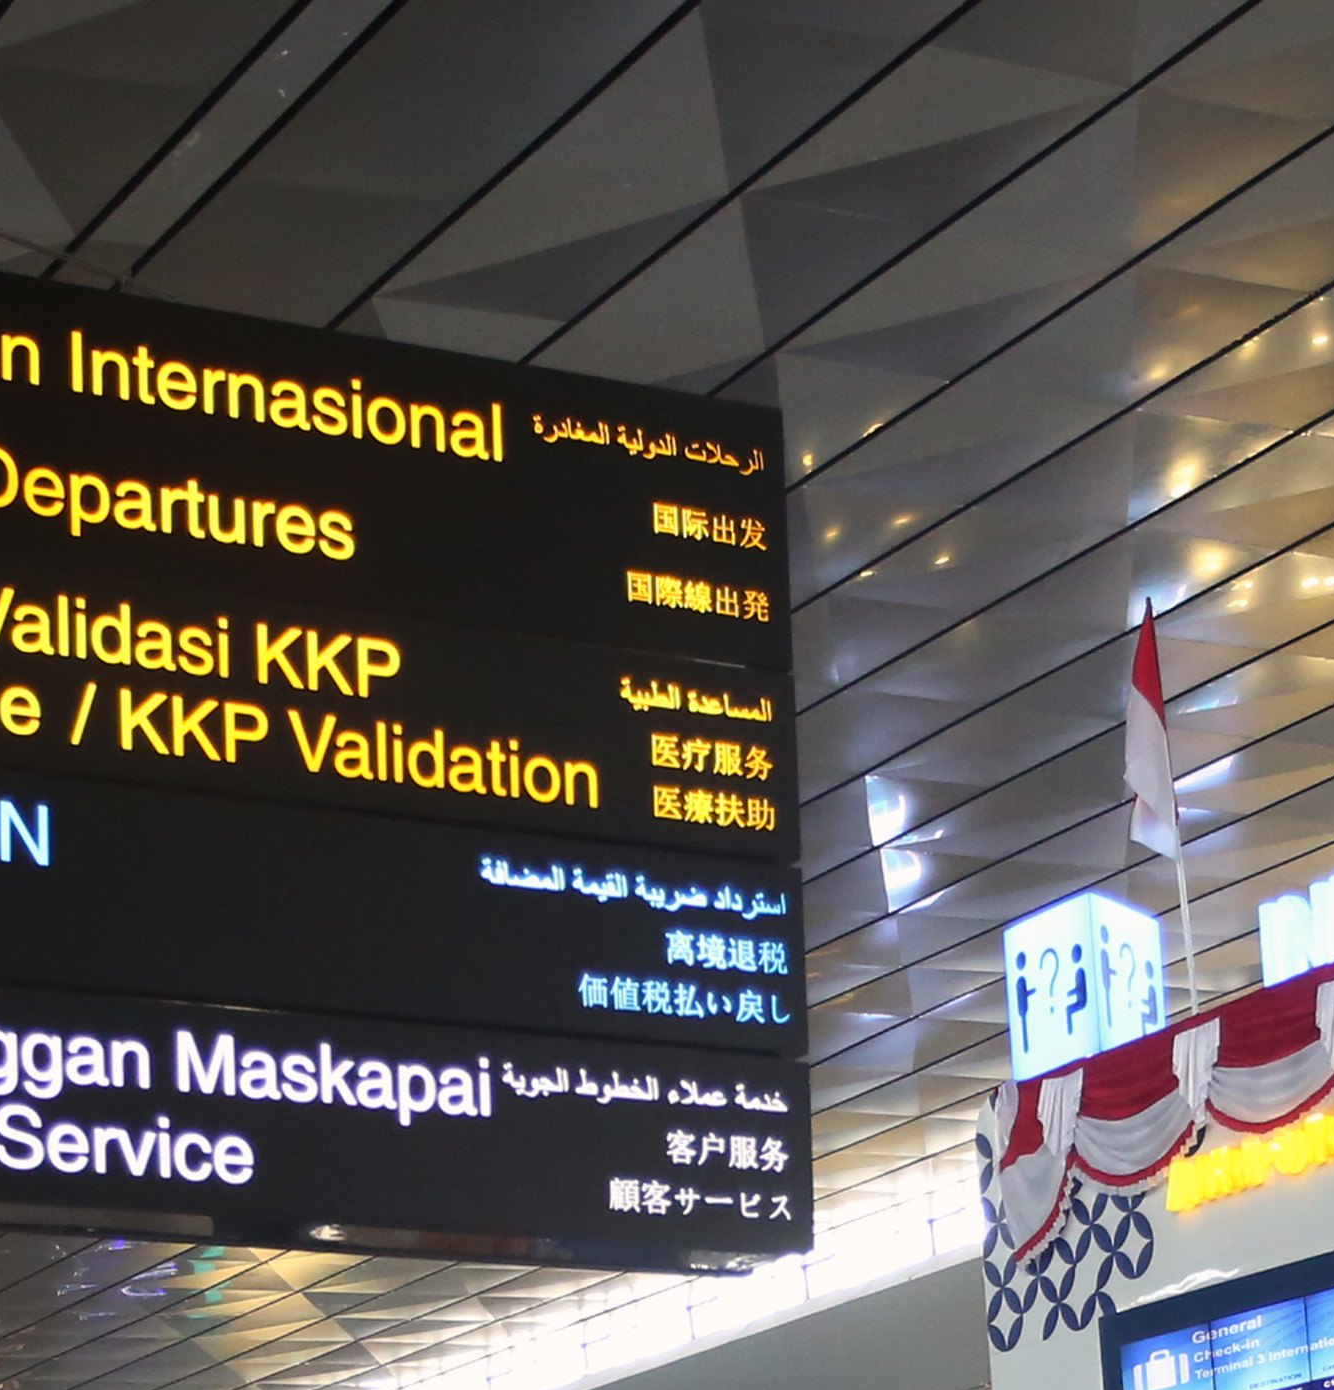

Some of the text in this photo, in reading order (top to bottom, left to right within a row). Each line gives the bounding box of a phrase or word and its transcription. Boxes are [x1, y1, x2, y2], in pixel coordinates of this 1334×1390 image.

[71, 330, 503, 462] Internasional
[532, 414, 764, 475] الرحلات الدولية المغادرة
[653, 501, 766, 550] 国际出发
[626, 569, 769, 622] 国際線出発
[255, 621, 400, 698] KKP
[619, 676, 773, 723] المساعدة الطبية
[70, 681, 97, 745] /
[119, 687, 268, 763] KKP
[287, 708, 599, 808] Validation
[651, 732, 773, 780] 医疗服务
[653, 784, 775, 831] 医療扶助
[480, 855, 787, 921] استرداد ضريبة القيمة المضافة
[665, 926, 789, 975] 离境退税
[577, 971, 790, 1024] 価値税払い戻し
[173, 1028, 492, 1127] Maskapai
[501, 1062, 788, 1112] خدمة عملاء الخطوط الجوية
[666, 1128, 789, 1173] 客户服务
[609, 1176, 791, 1221] 顧客サービス
[1190, 1313, 1263, 1346] General
[1192, 1334, 1261, 1365] Check-in
[1193, 1354, 1254, 1381] Terminal
[1255, 1351, 1265, 1366] 3
